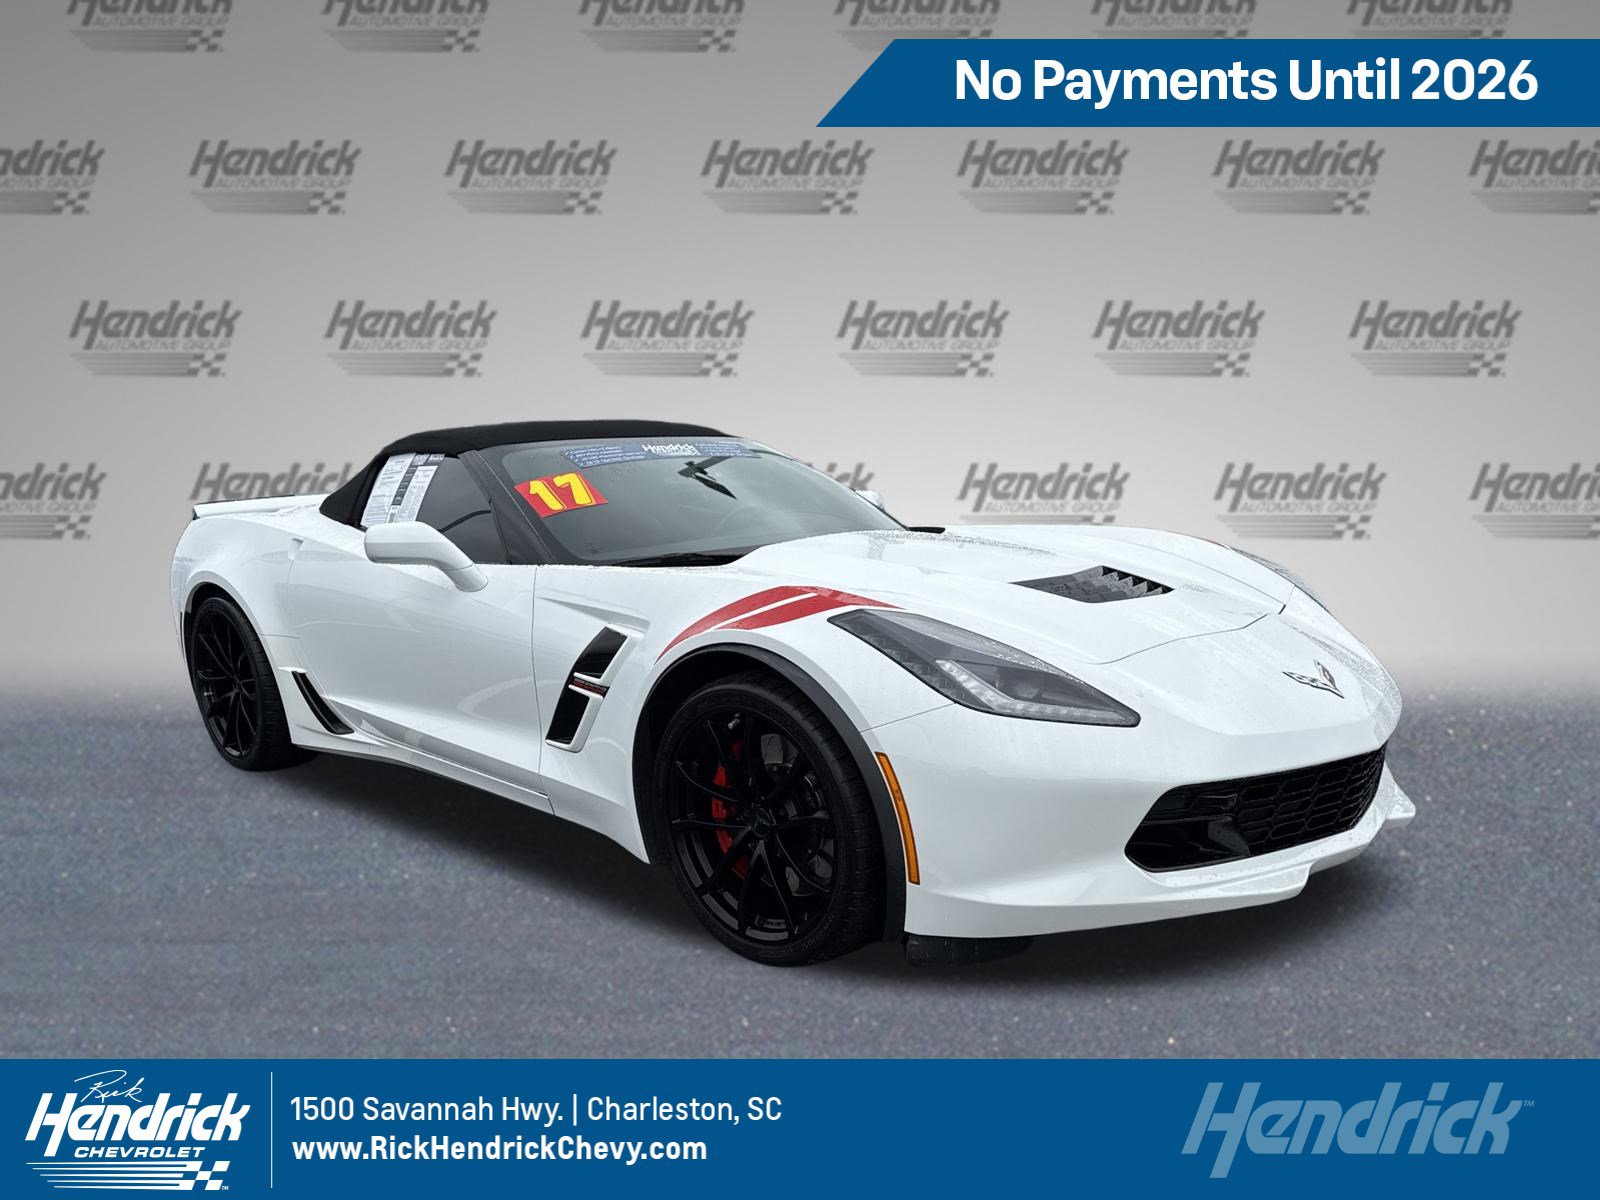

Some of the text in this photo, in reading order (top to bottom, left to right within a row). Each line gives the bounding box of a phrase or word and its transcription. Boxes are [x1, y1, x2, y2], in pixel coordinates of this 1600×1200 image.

[0, 140, 105, 176] ndrick
[188, 140, 362, 188] Hendrick
[444, 140, 618, 188] Hendrick
[700, 140, 874, 188] Hendrick
[956, 140, 1130, 188] Hendrick
[1213, 140, 1387, 188] Hendrick
[1469, 140, 1600, 188] Hendri
[69, 300, 242, 350] Hendrick
[325, 300, 498, 350] Hendrick
[581, 300, 754, 350] Hendrick
[837, 300, 1010, 350] Hendrick
[1093, 300, 1266, 350] Hendrick
[1349, 300, 1522, 350] Hendrick
[0, 462, 106, 500] ndrick
[528, 473, 596, 512] 17
[957, 462, 1130, 512] Hendrick
[1214, 462, 1387, 512] Hendrick
[1469, 462, 1600, 512] Hendri
